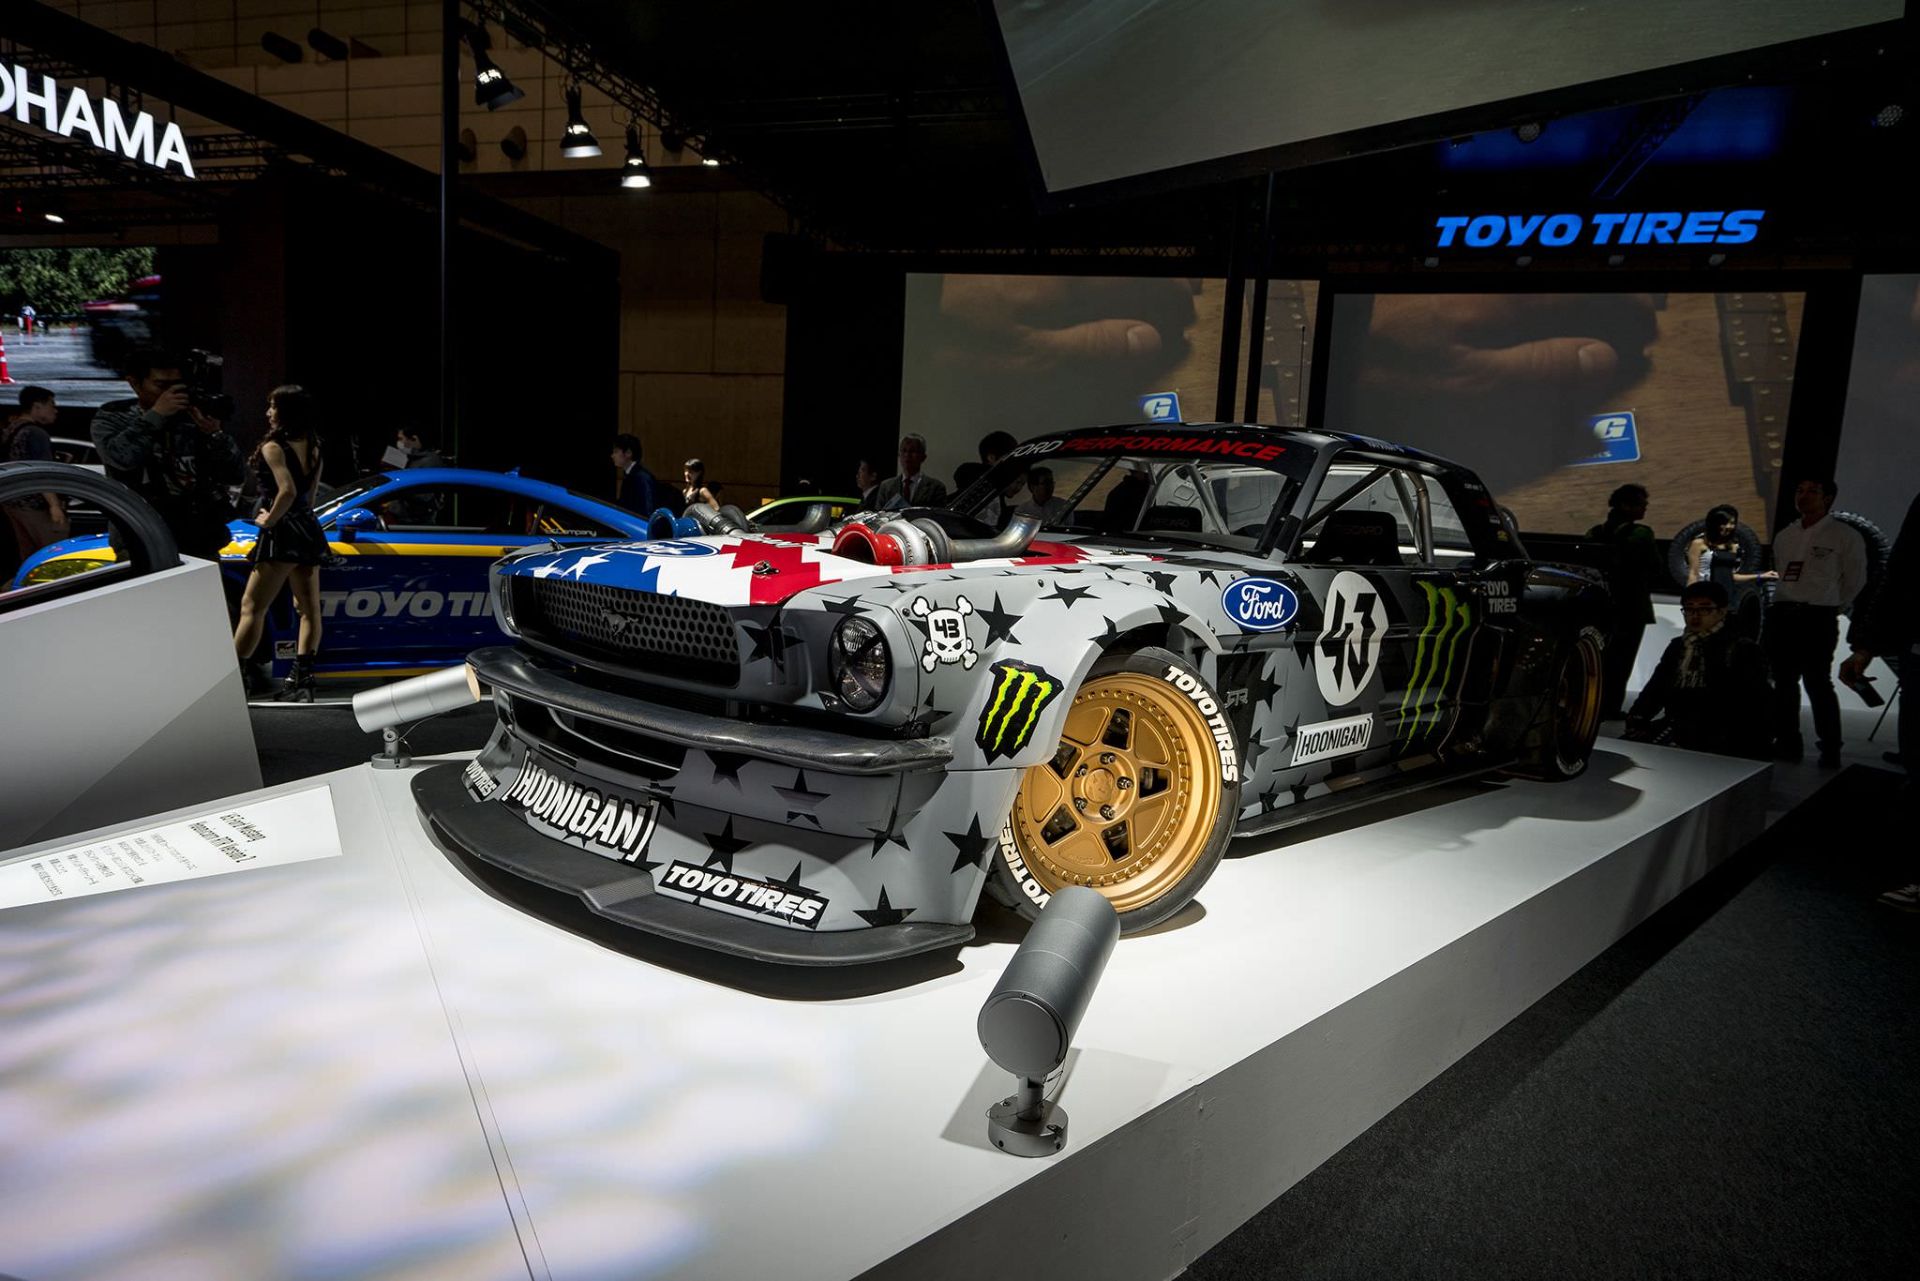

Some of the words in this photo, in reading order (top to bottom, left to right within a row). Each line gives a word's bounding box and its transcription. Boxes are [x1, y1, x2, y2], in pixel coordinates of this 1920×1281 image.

[1436, 213, 1583, 248] TOYO
[1592, 210, 1766, 245] TIRES
[1002, 440, 1063, 462] FORD
[1061, 436, 1287, 461] PERFORMANCE
[319, 590, 444, 618] TOYO
[1238, 583, 1285, 620] Ford
[1483, 580, 1509, 597] OYO
[1488, 597, 1517, 613] TIRES
[933, 618, 960, 639] 43
[1319, 589, 1378, 693] 43
[1164, 665, 1218, 716] TOYO
[1207, 712, 1239, 782] TIRES
[1293, 718, 1373, 762] [HOONIGAN]
[473, 771, 498, 797] TIRES
[665, 865, 739, 898] TOYO
[735, 883, 824, 921] TIRES
[1021, 878, 1051, 910] YO
